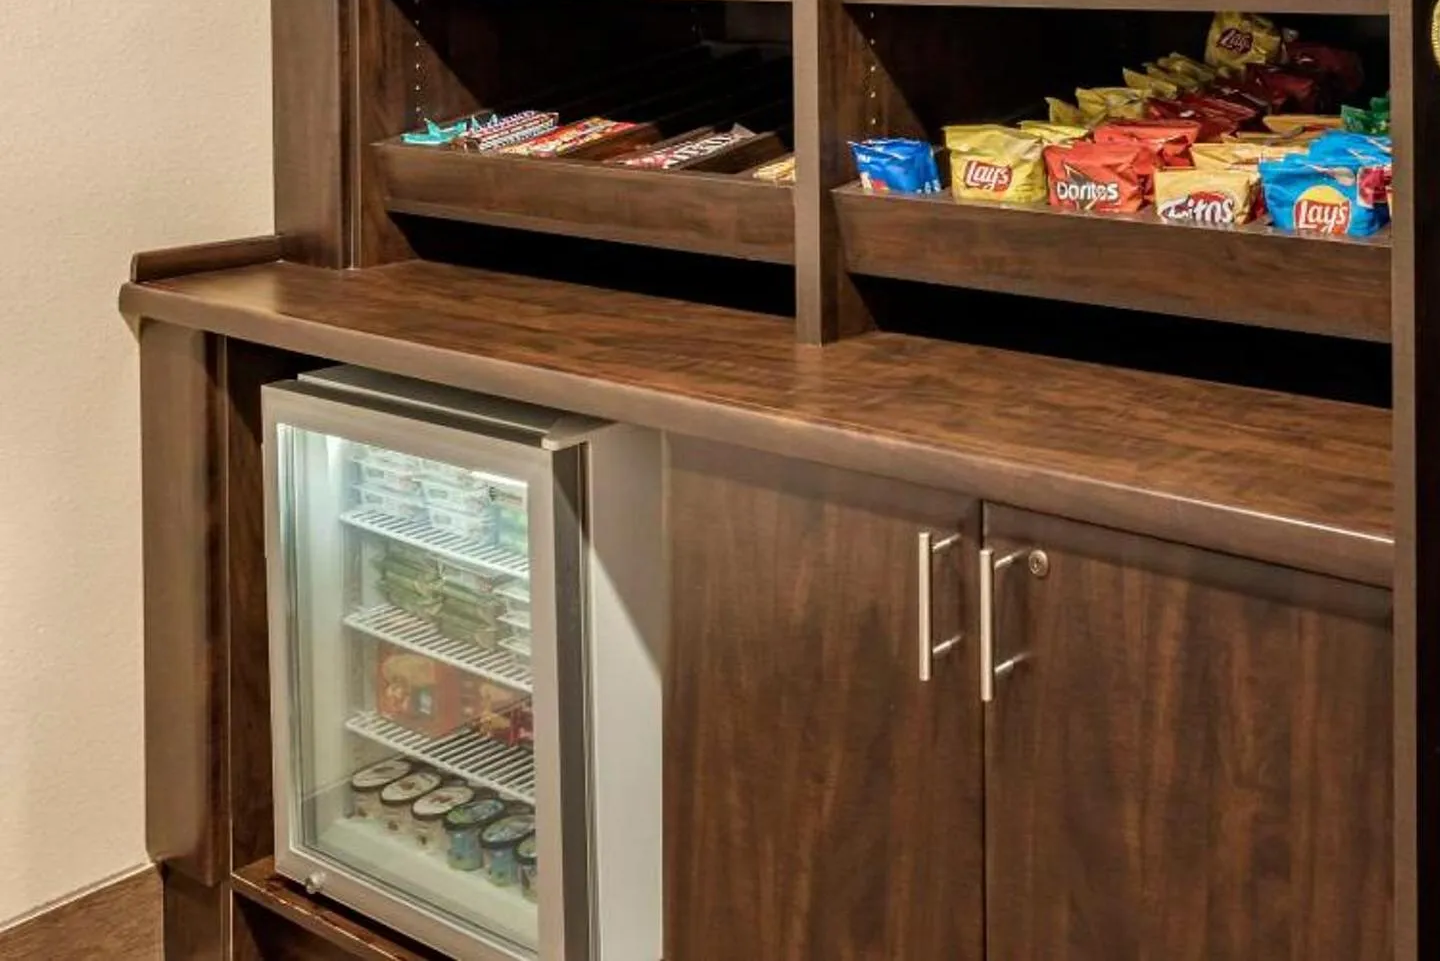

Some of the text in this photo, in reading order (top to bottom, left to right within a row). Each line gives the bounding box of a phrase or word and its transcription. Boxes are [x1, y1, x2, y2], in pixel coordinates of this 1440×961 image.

[967, 160, 1010, 190] Lay's
[1056, 181, 1119, 201] Doritos
[1299, 200, 1349, 233] Lay's
